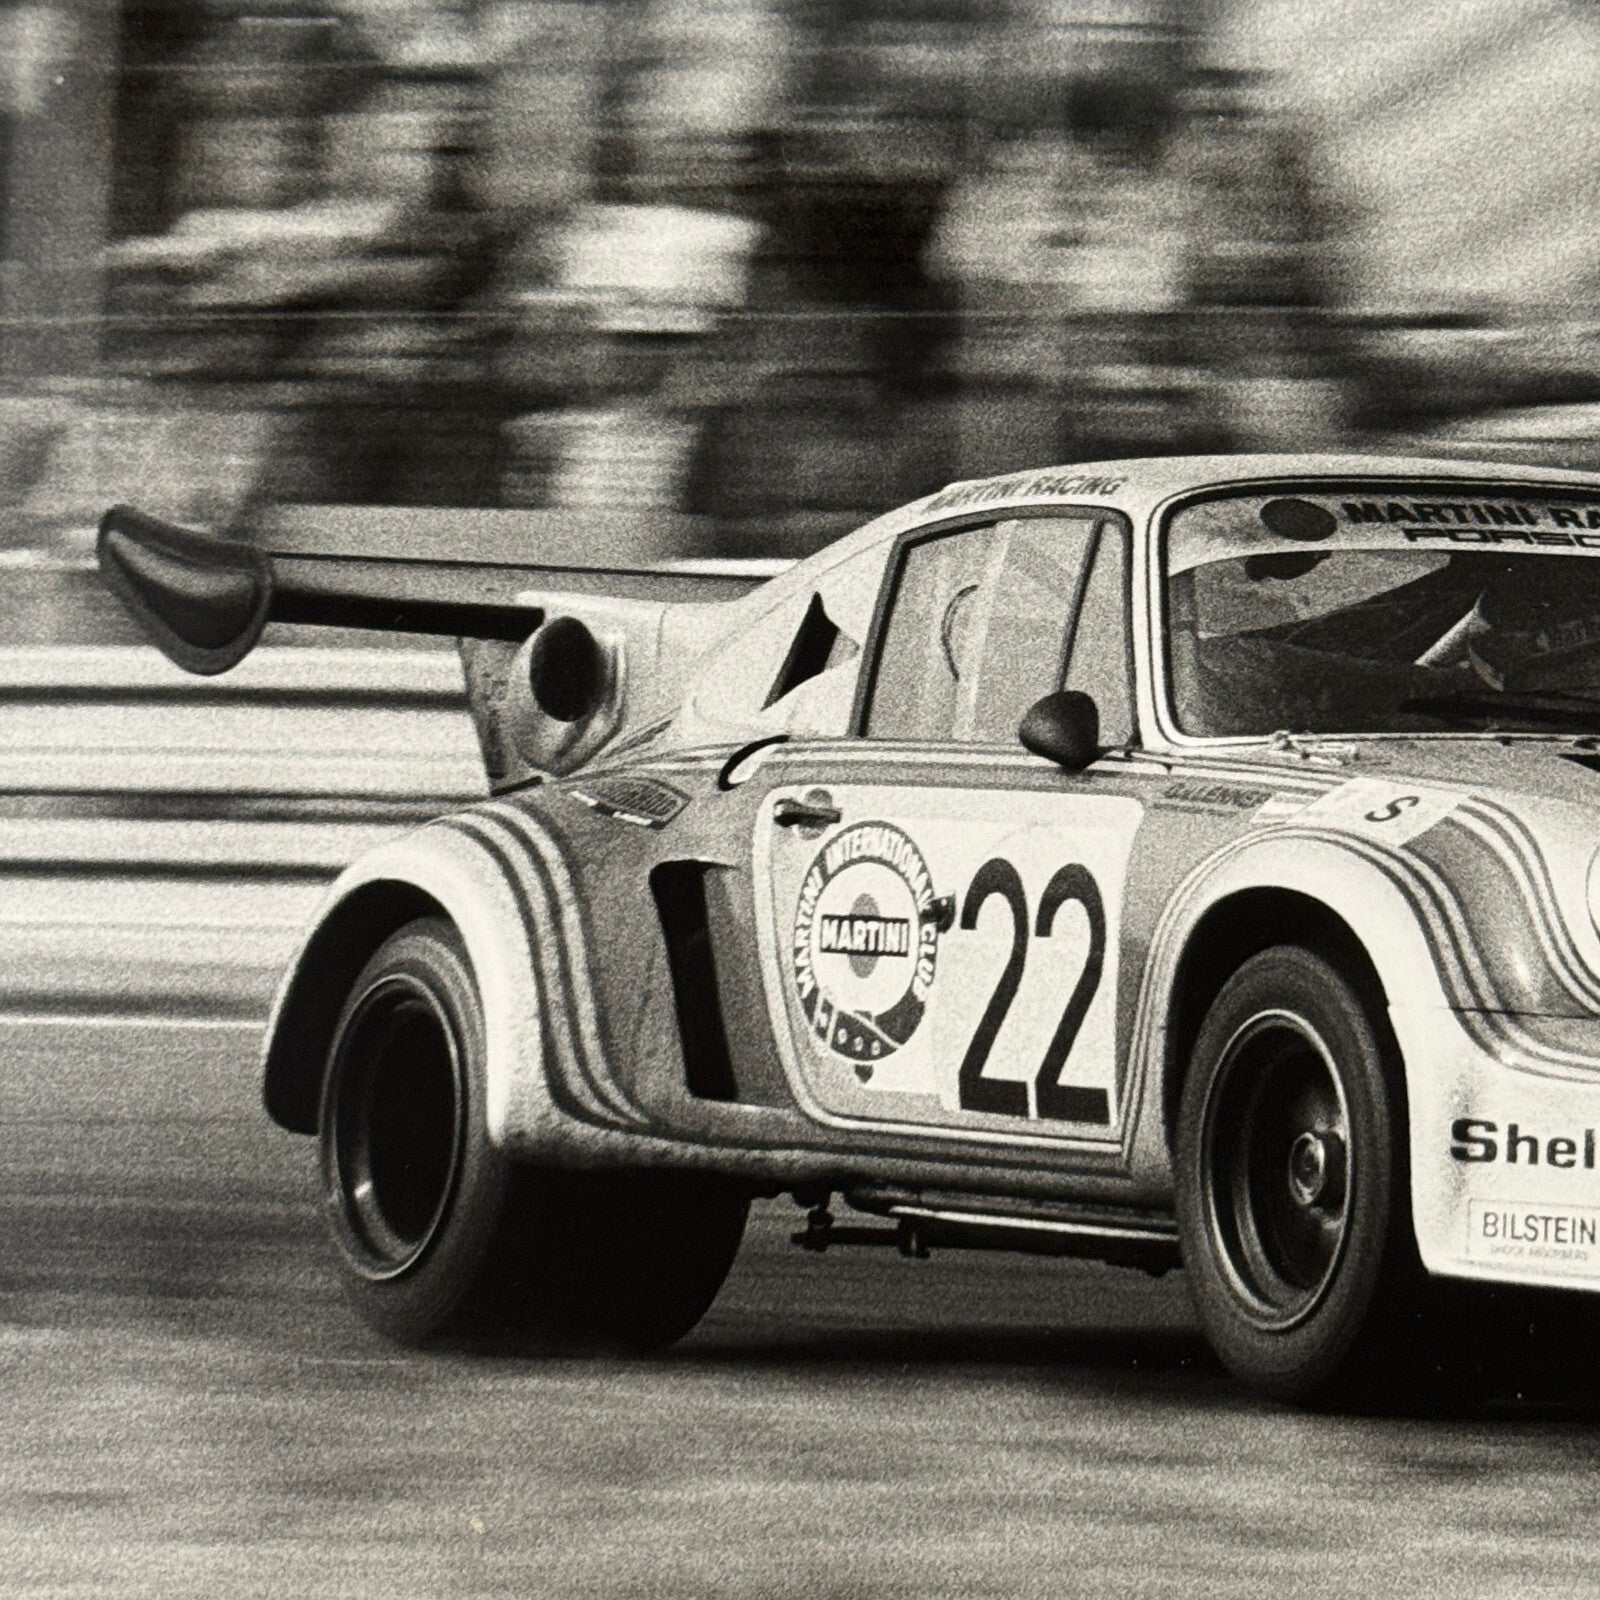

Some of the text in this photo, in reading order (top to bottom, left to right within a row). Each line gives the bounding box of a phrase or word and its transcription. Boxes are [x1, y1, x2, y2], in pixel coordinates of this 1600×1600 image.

[1024, 475, 1128, 496] RACING
[1341, 501, 1538, 525] MARTINI
[1364, 796, 1420, 823] S
[794, 866, 824, 999] MARTINI
[913, 922, 937, 1002] CLUB
[821, 918, 909, 952] MARTINI
[959, 857, 1110, 1126] 22
[1450, 1118, 1595, 1169] Shel
[1483, 1211, 1595, 1245] BILSTEIN
